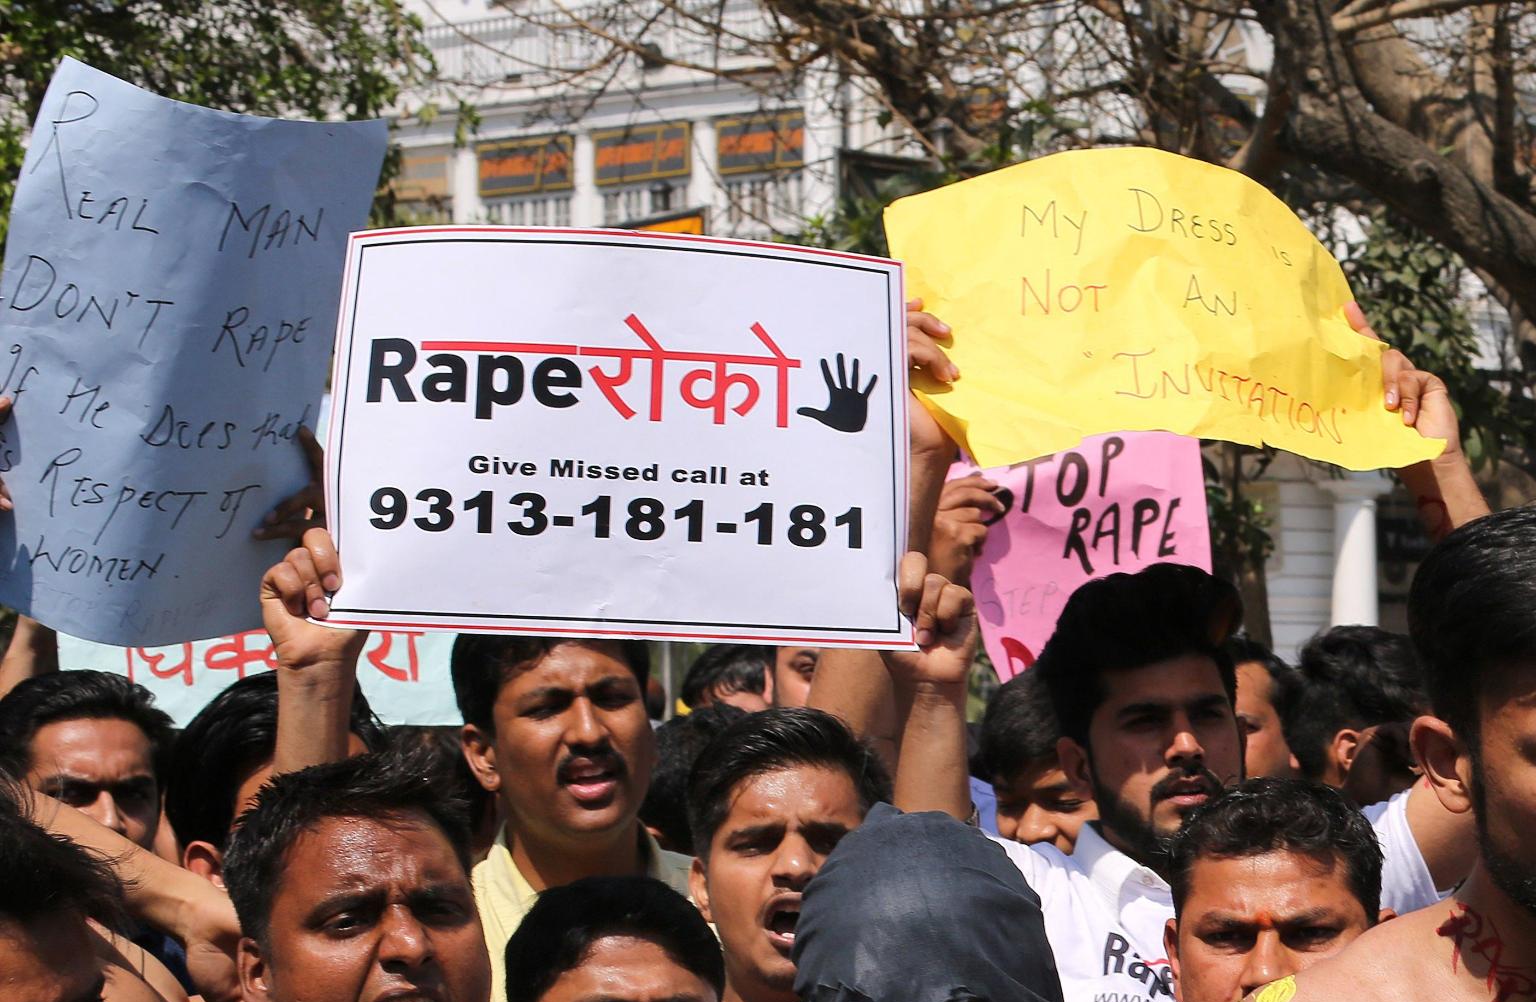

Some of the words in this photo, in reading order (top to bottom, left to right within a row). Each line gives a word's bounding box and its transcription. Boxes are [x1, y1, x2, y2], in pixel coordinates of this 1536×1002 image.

[218, 201, 324, 259] MAN
[10, 255, 174, 348] DON'T
[1021, 268, 1108, 316] NOT
[1183, 274, 1237, 316] AN
[59, 377, 110, 428] He
[468, 454, 537, 476] Give
[549, 458, 659, 483] Missed
[671, 464, 728, 486] call
[739, 468, 770, 487] at
[369, 486, 864, 550] 9313-181-181
[1062, 497, 1183, 576] RAPE
